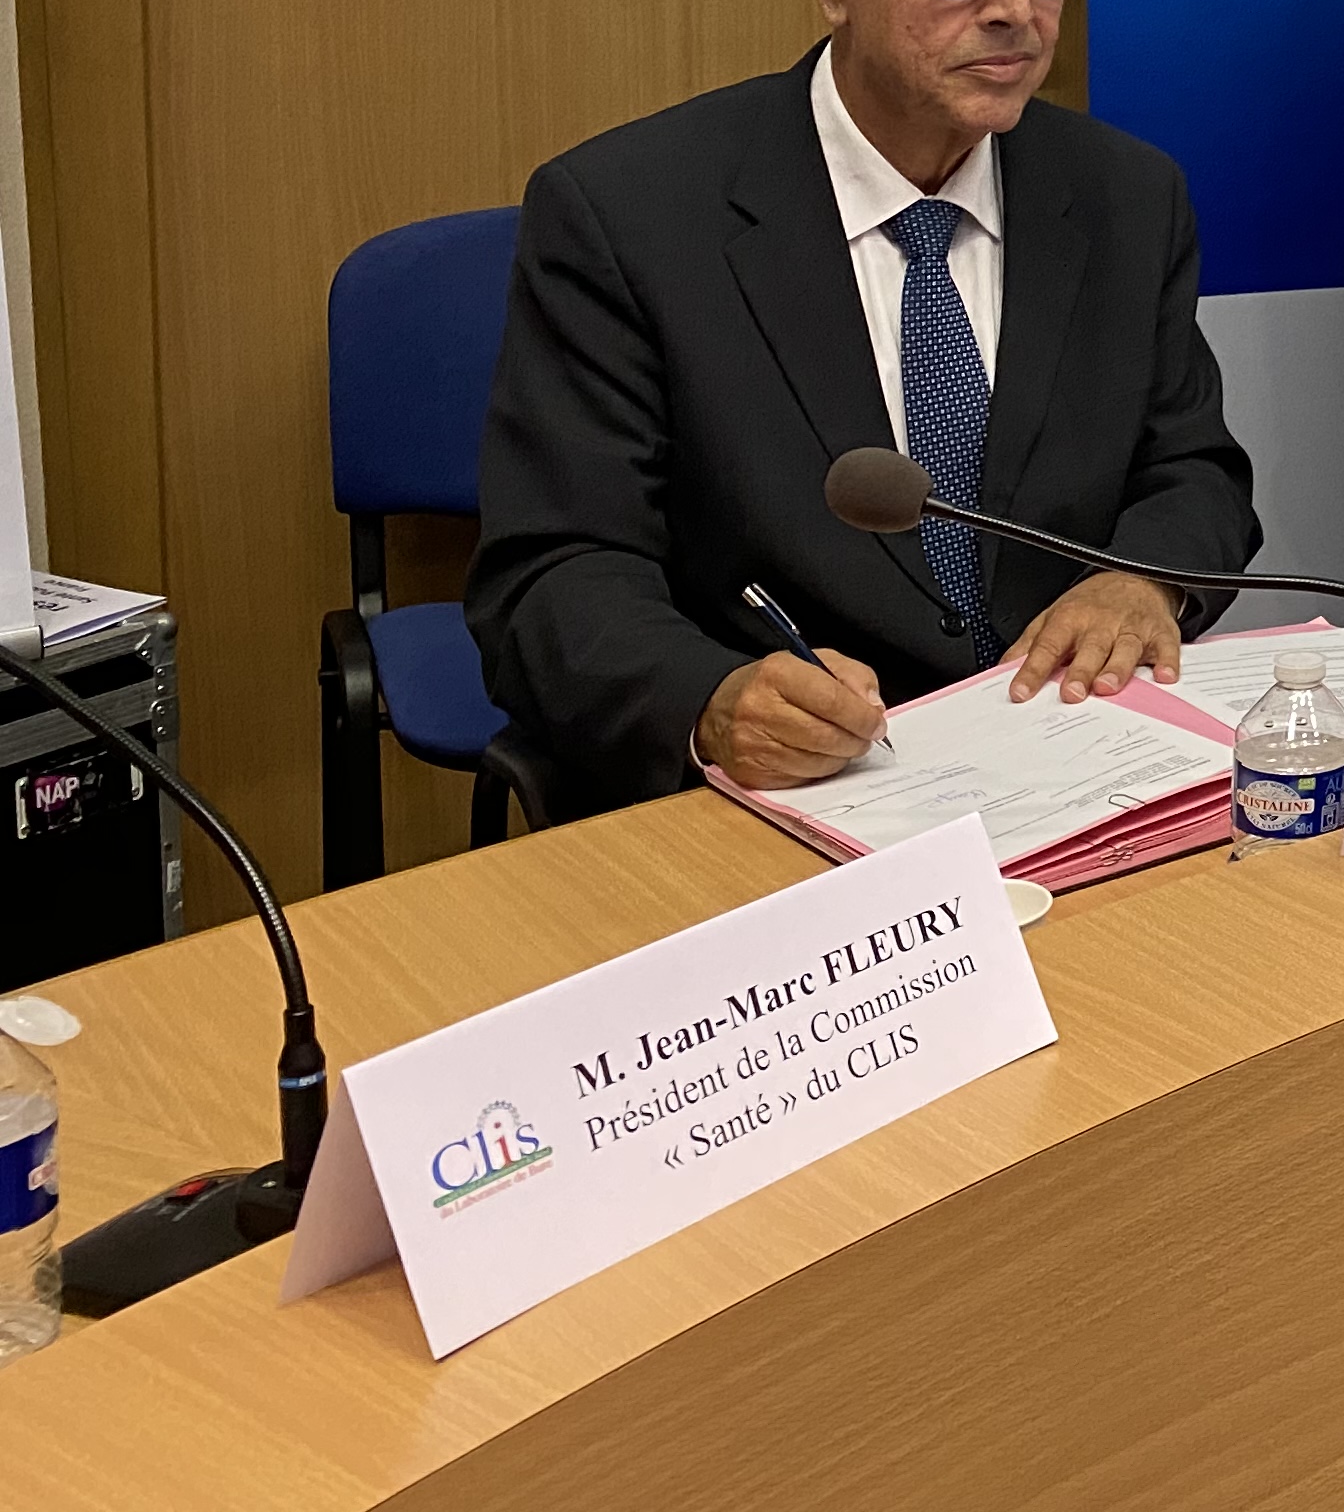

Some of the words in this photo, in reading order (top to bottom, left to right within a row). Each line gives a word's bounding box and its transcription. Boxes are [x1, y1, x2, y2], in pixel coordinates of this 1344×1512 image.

[570, 1050, 626, 1099] M.
[636, 972, 816, 1070] Jean-Marc
[819, 896, 964, 986] FLEURY
[583, 1063, 729, 1152] Président
[736, 1046, 771, 1080] de
[774, 1030, 805, 1060] la
[810, 954, 977, 1043] Commission
[432, 1121, 540, 1191] Clis
[689, 1093, 773, 1157] Santé
[806, 1067, 842, 1101] du
[847, 1023, 919, 1078] CLIS
